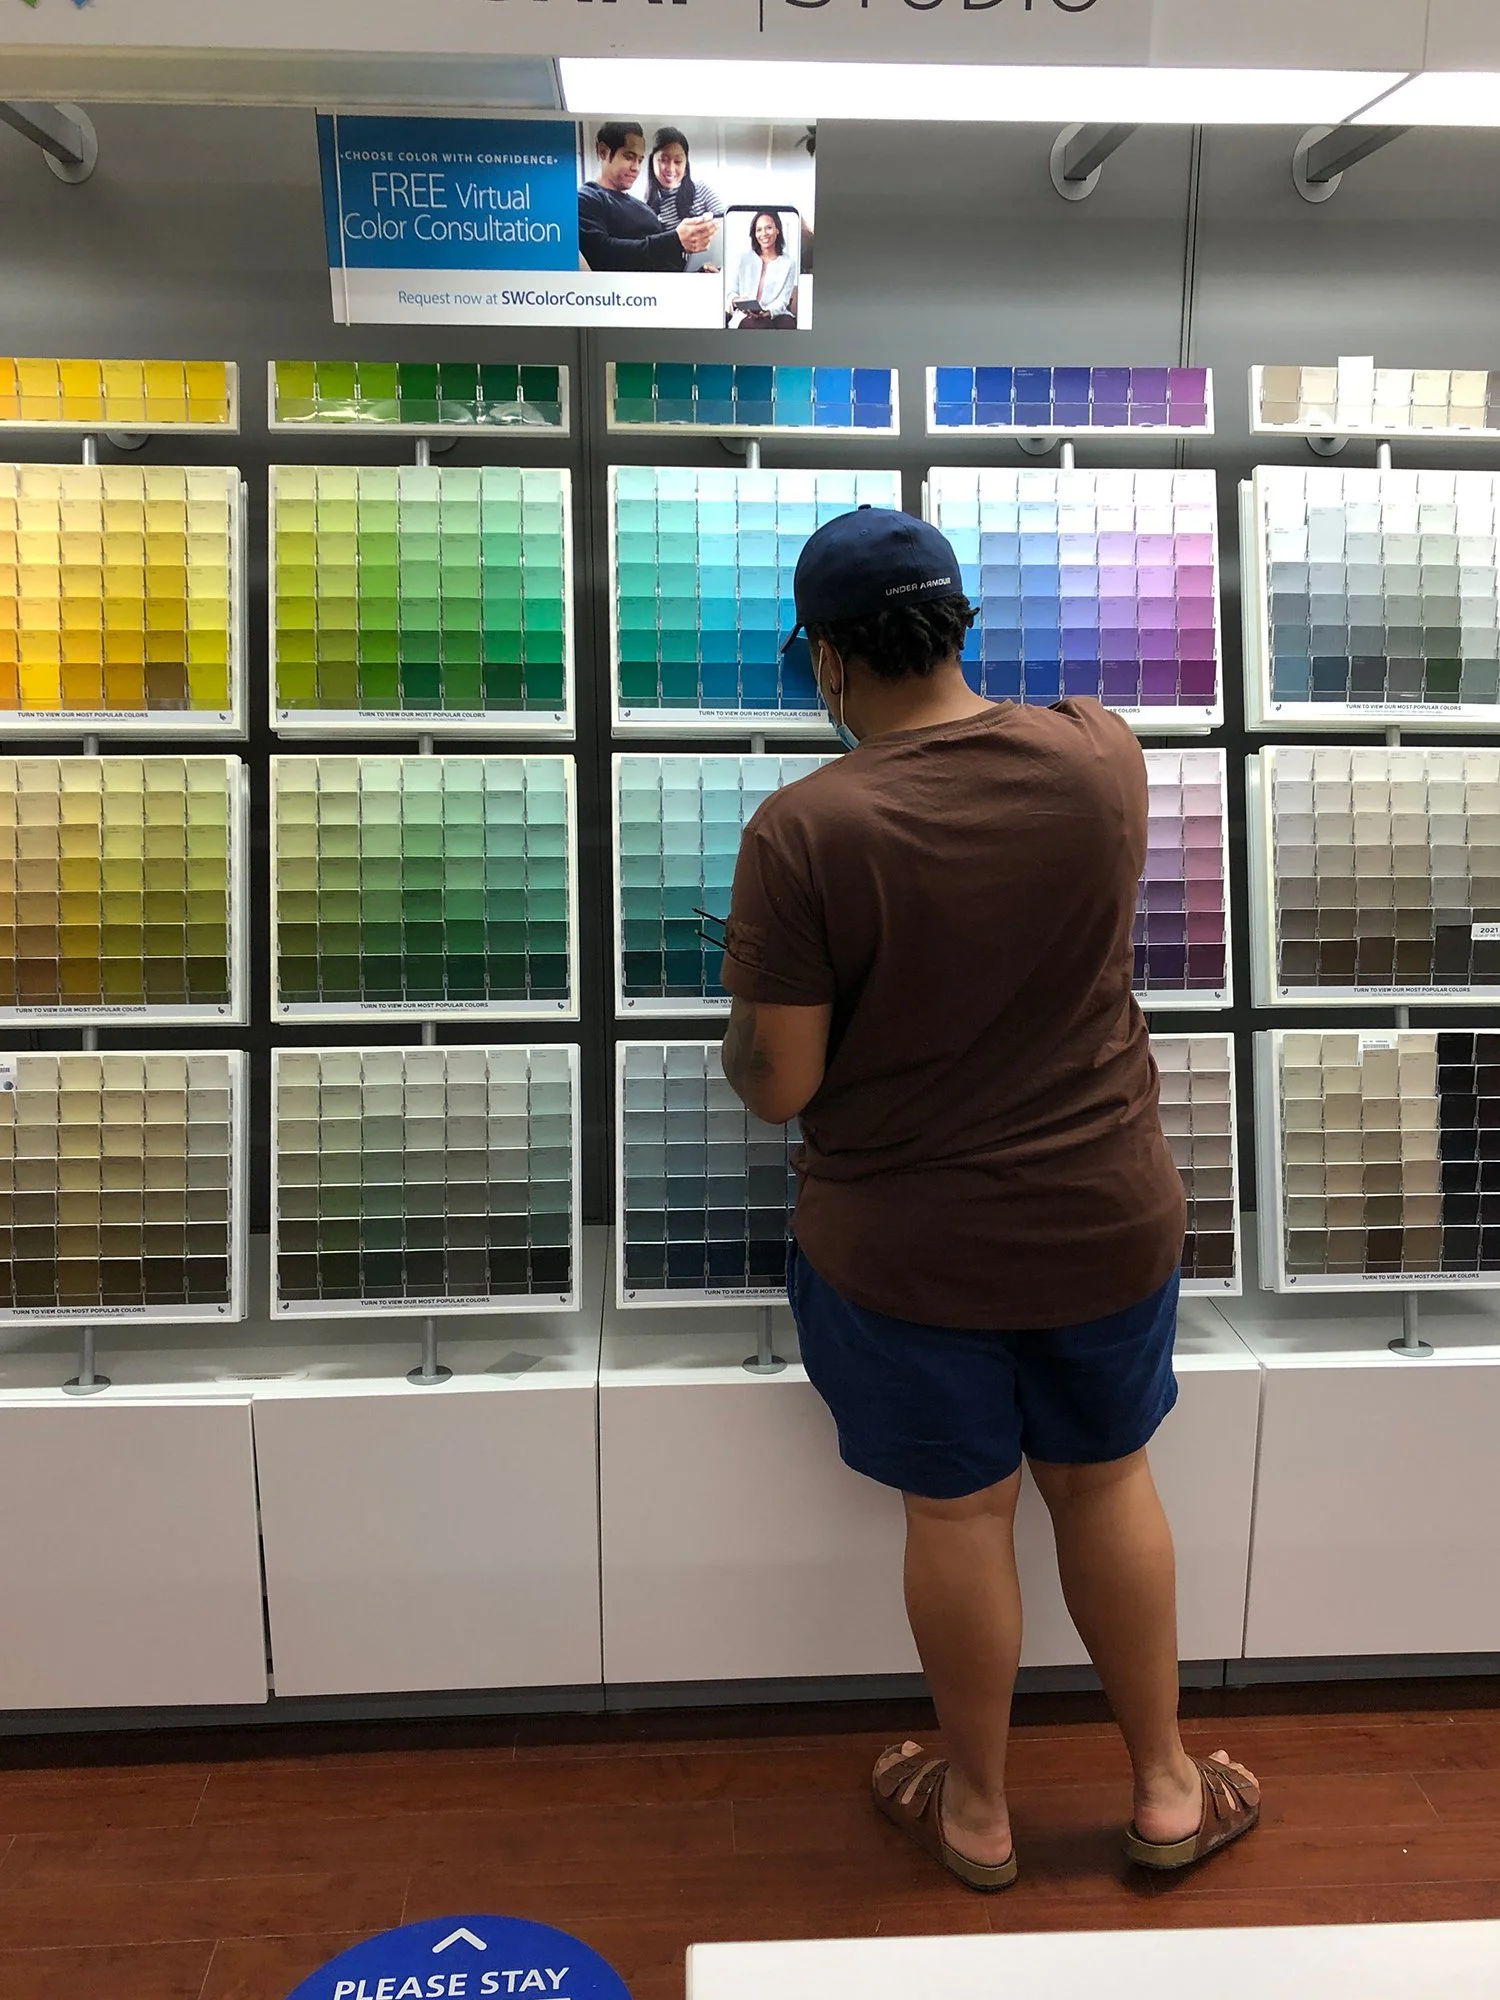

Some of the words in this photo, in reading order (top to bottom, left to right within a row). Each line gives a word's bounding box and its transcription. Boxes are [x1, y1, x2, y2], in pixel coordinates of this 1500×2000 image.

[398, 152, 438, 162] COLOR
[442, 153, 473, 163] WITH
[371, 172, 447, 209] FREE
[455, 182, 530, 210] Virtual
[344, 212, 407, 241] Color
[414, 214, 561, 243] Consultation
[398, 290, 450, 306] Request
[454, 293, 482, 305] now
[485, 294, 498, 305] at
[501, 290, 657, 307] SWColorConsult.com
[886, 583, 918, 596] UNDER
[920, 577, 951, 590] ARMOUR
[334, 1973, 468, 2000] PLEASE
[481, 1967, 569, 1995] STAY
